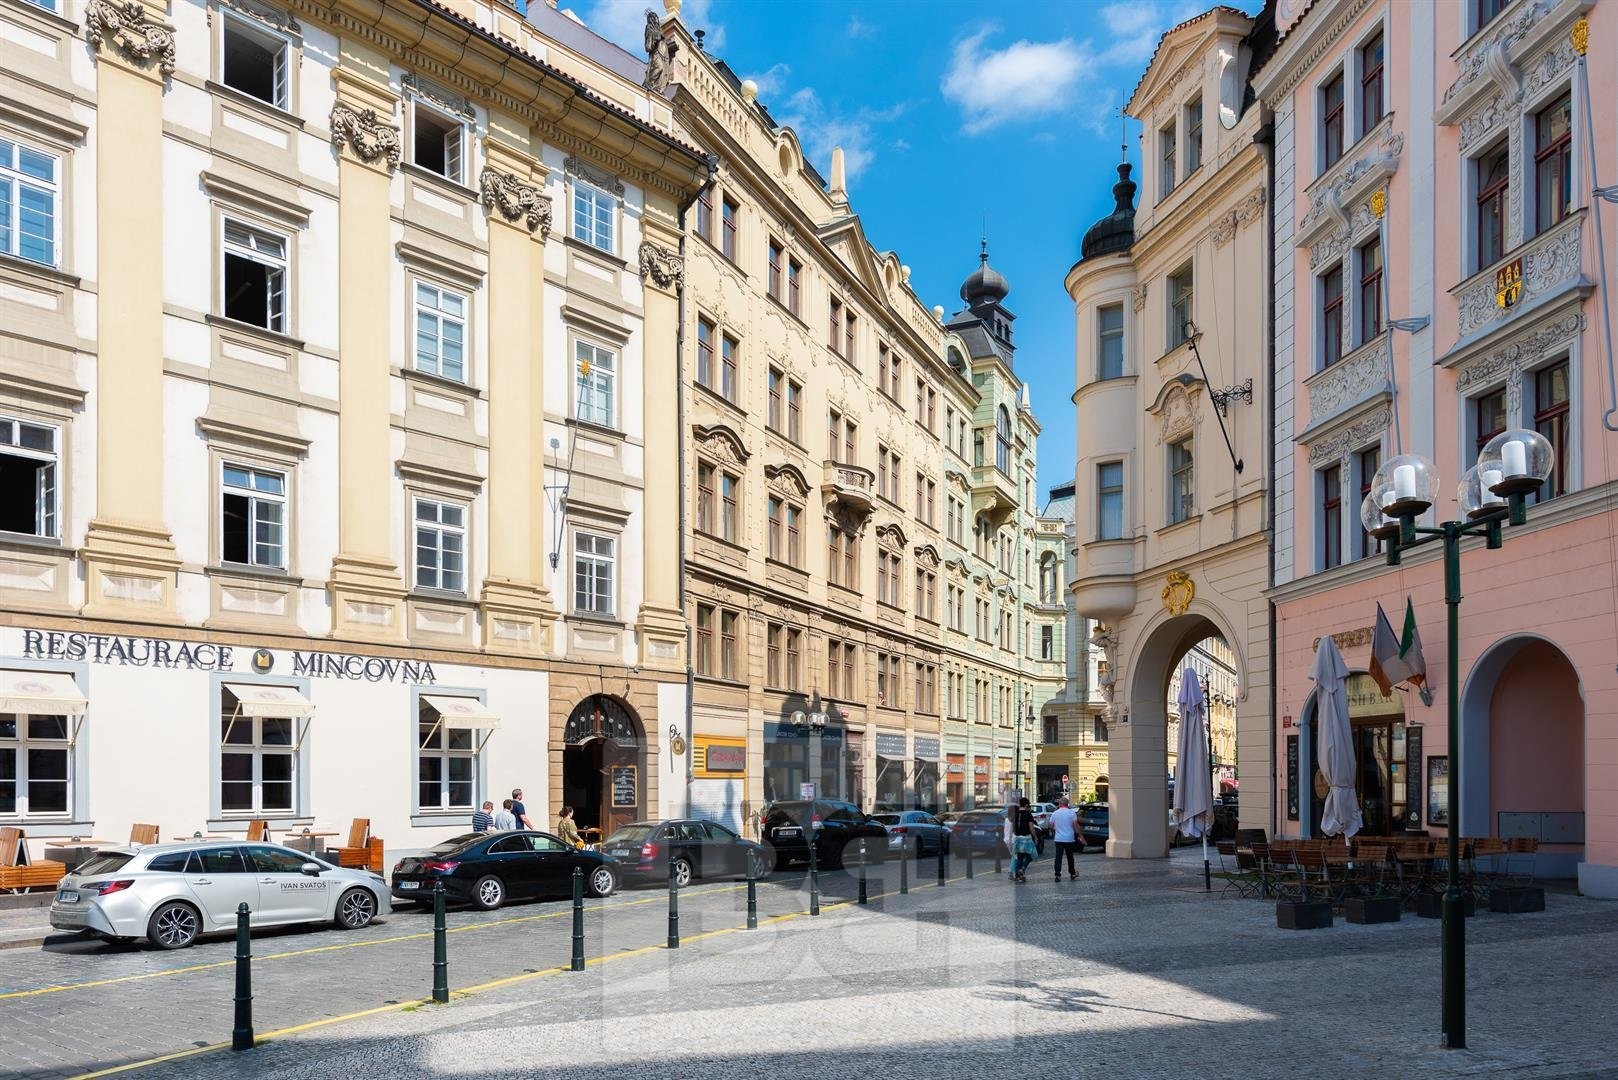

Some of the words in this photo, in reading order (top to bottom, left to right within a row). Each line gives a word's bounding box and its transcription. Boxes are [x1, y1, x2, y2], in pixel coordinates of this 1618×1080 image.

[23, 629, 234, 669] RESTAURACE
[292, 651, 437, 683] MINCOVNA
[1347, 694, 1366, 706] ISH
[300, 880, 327, 889] SVATOŠ
